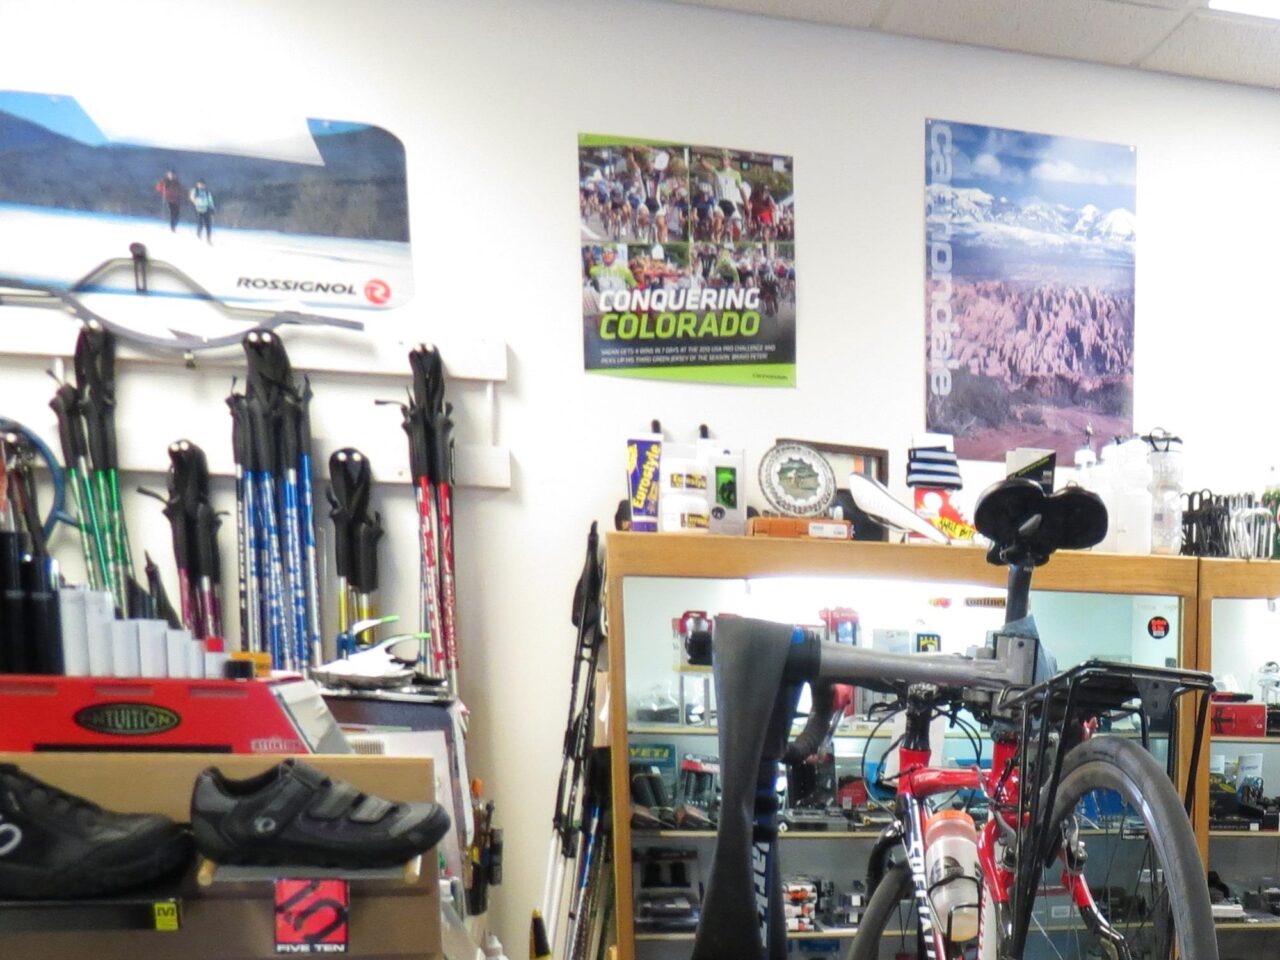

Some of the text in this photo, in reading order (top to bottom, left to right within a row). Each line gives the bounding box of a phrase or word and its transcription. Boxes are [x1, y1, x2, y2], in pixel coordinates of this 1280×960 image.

[236, 276, 357, 295] ROSSIGNOL
[600, 287, 761, 311] CONQUERING
[600, 311, 761, 340] COLORADO
[633, 444, 661, 509] Eurostyle
[629, 747, 670, 758] YETI
[277, 943, 345, 953] FIVE TEN
